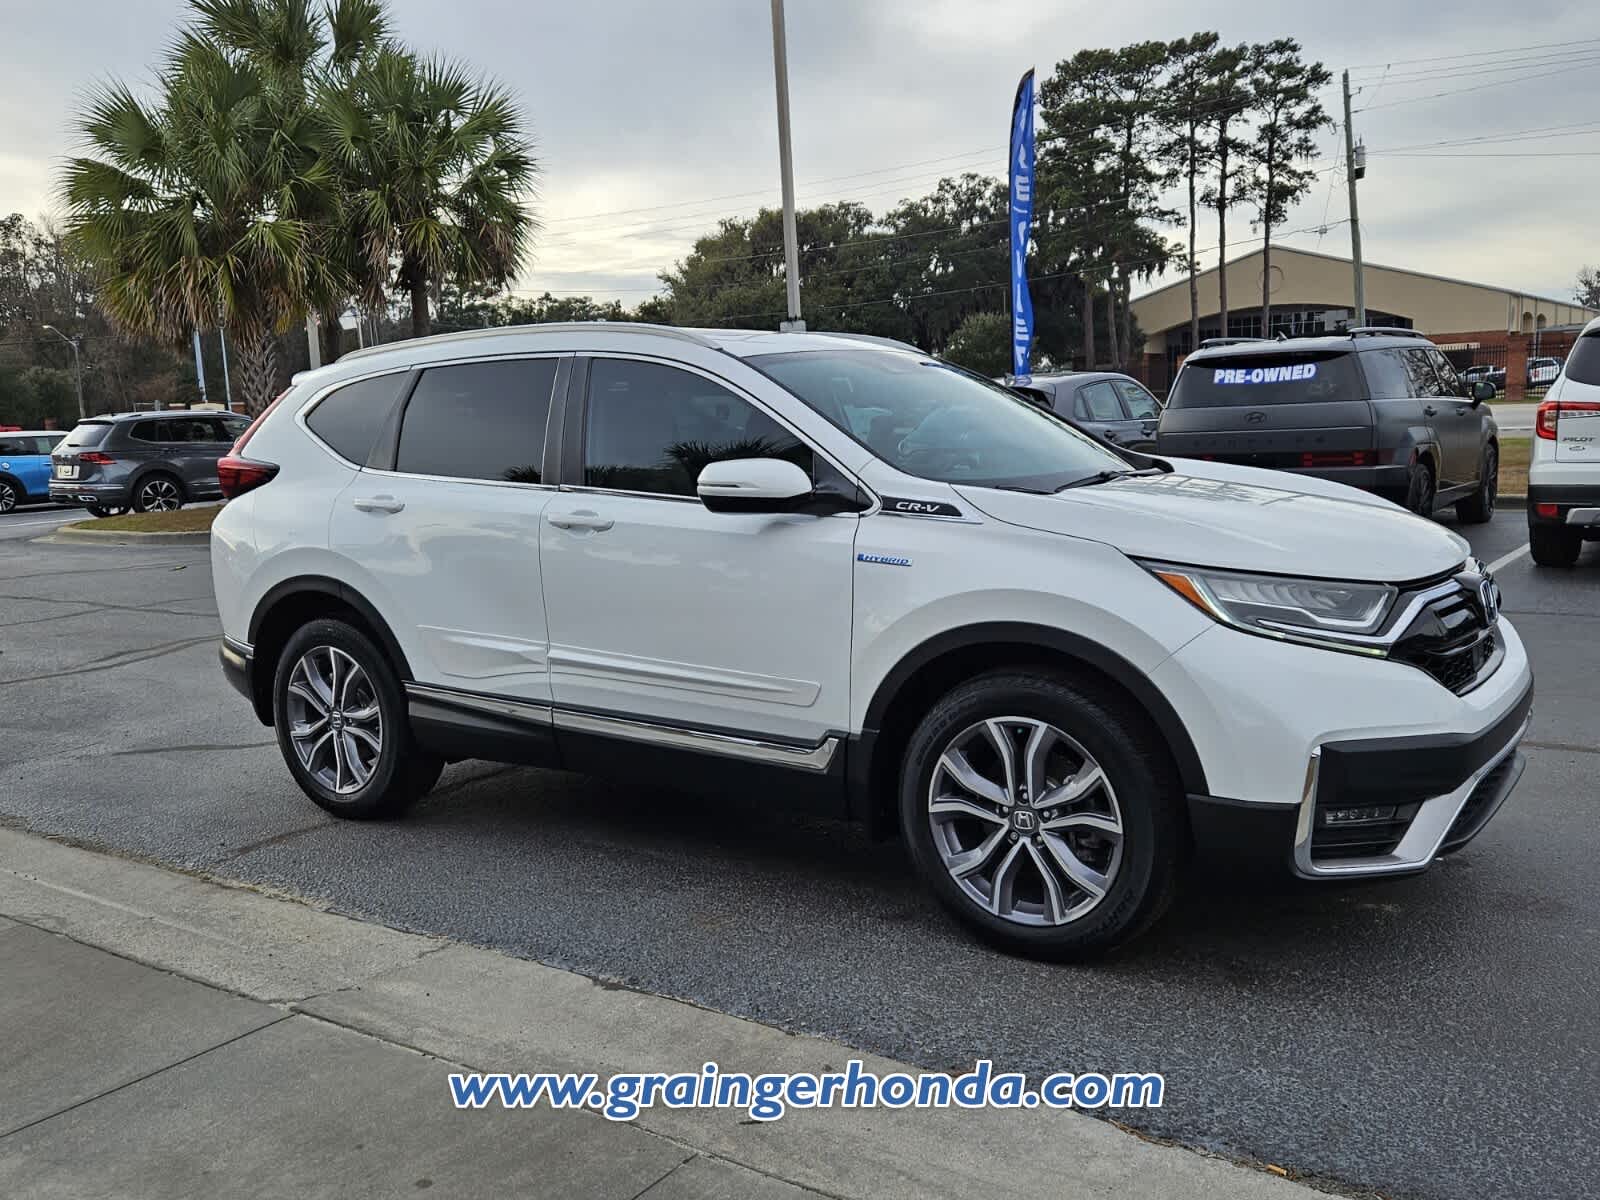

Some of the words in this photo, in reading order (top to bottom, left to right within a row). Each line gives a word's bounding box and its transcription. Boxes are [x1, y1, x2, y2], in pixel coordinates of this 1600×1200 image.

[1213, 364, 1317, 384] PRE-OWNED
[895, 501, 940, 512] CR-V
[863, 554, 910, 565] HYBRID
